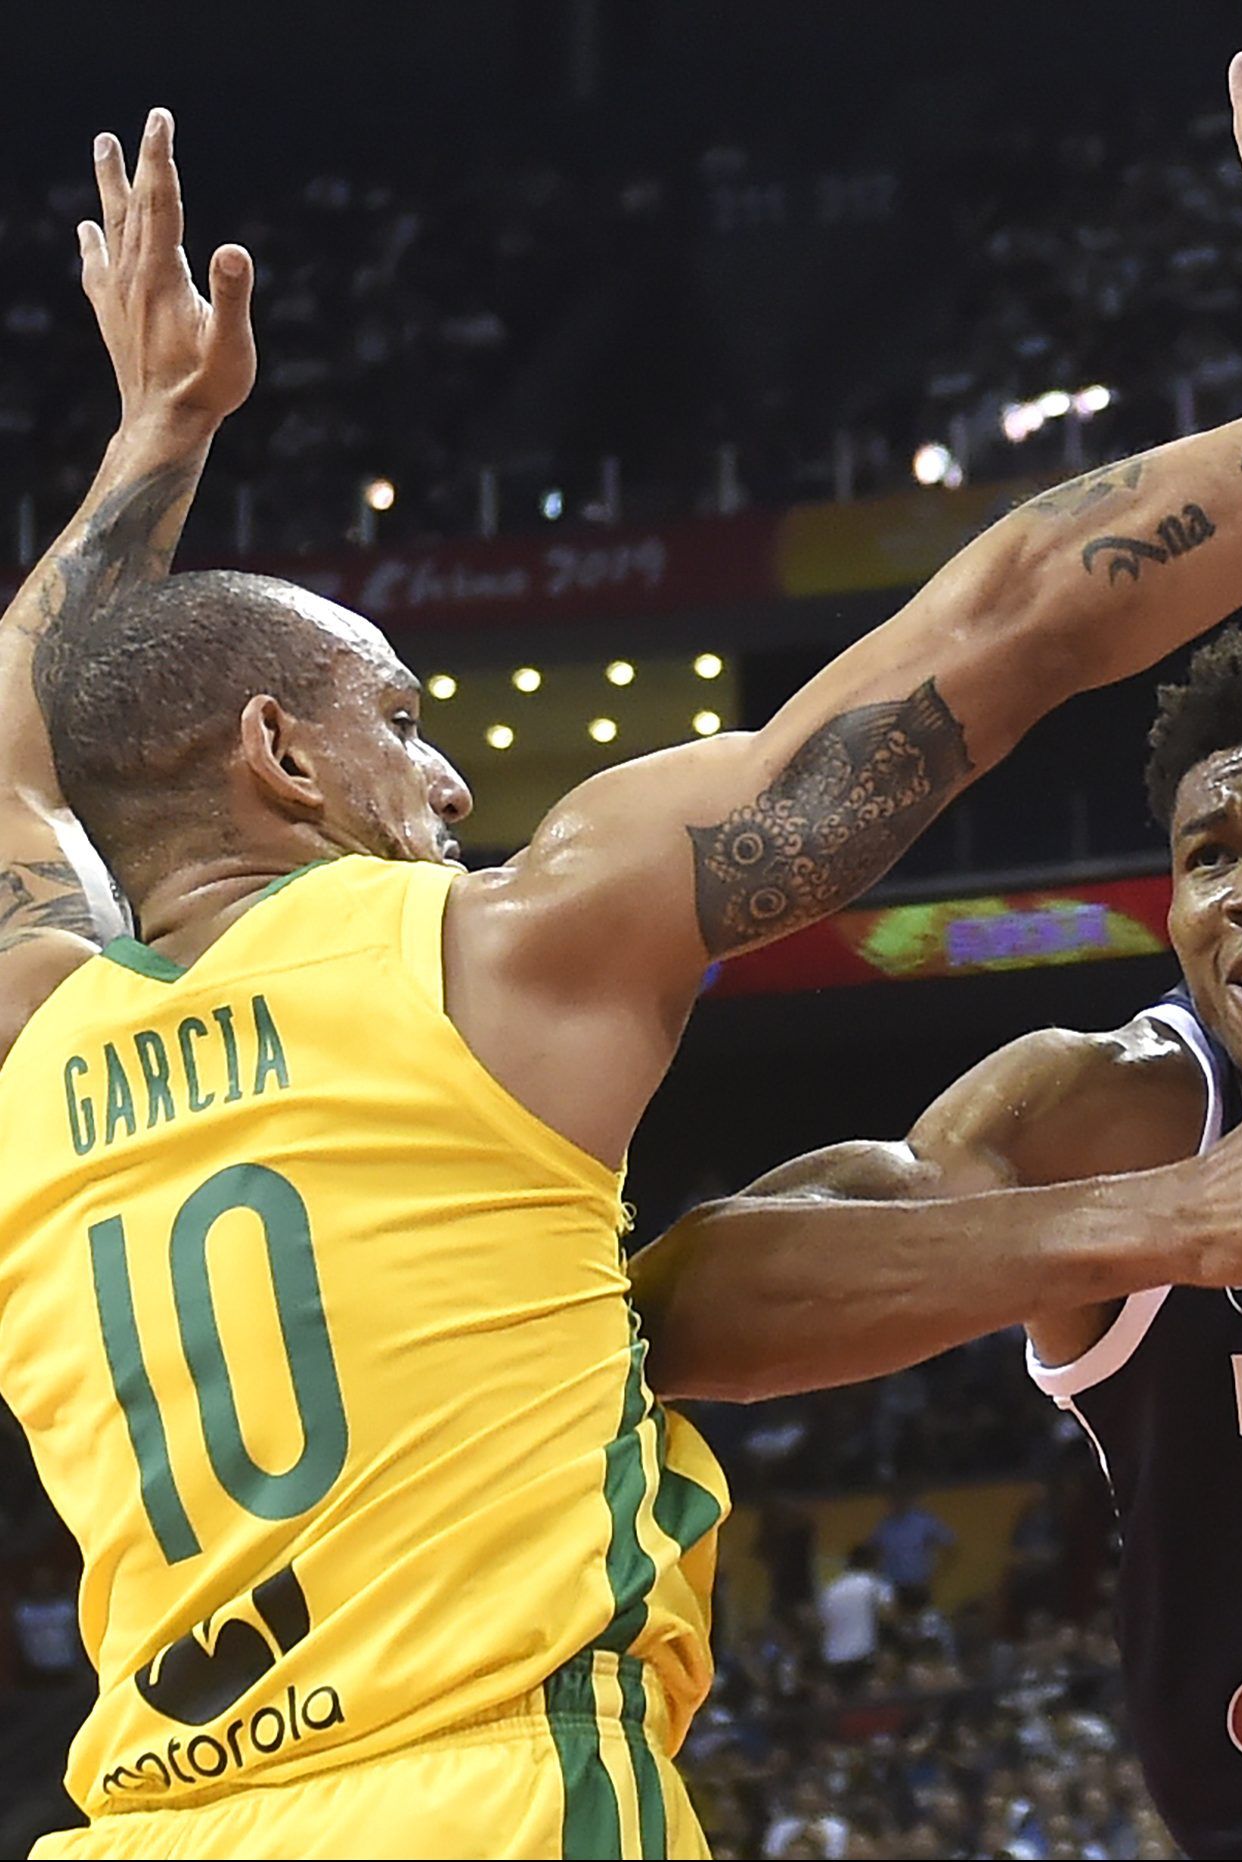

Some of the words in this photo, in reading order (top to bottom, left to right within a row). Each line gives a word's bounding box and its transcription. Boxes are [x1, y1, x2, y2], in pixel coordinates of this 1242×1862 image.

[64, 995, 291, 1157] GARCIA
[88, 1162, 349, 1565] 10
[102, 1685, 345, 1794] motorola
